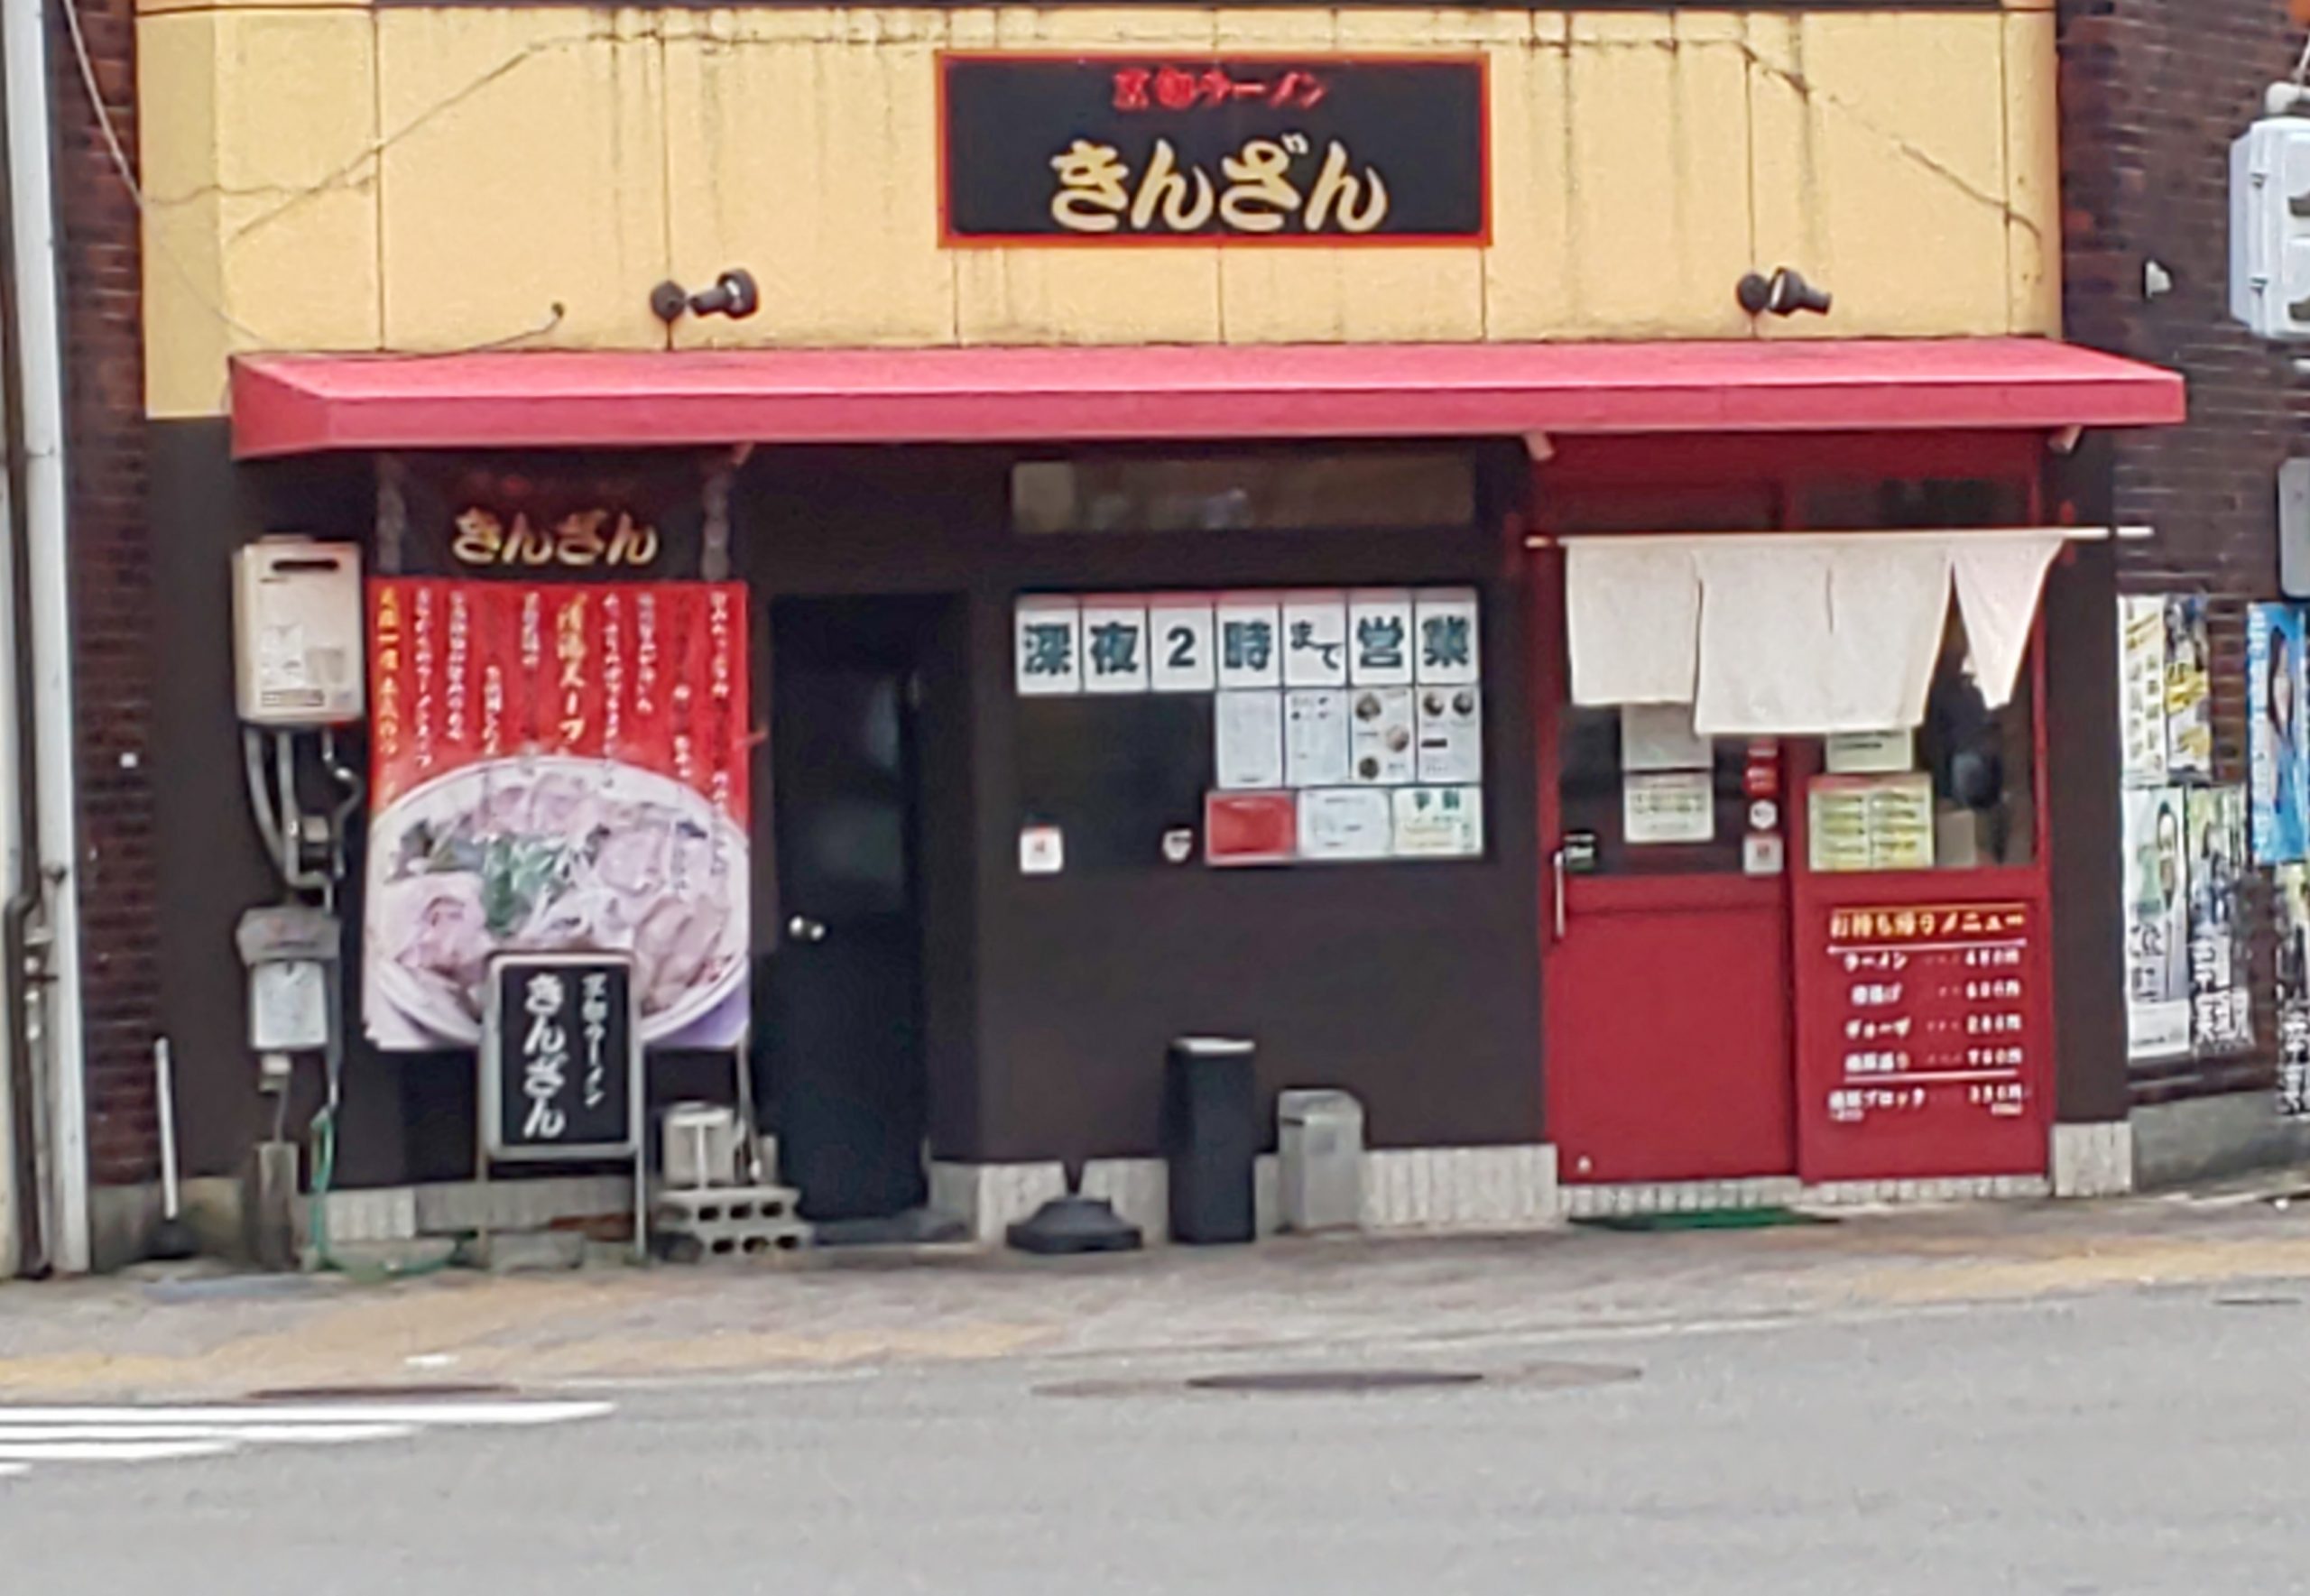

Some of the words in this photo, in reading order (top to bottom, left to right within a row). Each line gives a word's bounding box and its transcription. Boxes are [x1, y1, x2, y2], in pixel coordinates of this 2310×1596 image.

[1050, 132, 1389, 233] きんざん
[452, 506, 657, 567] きんざん
[523, 972, 569, 1139] きんざん
